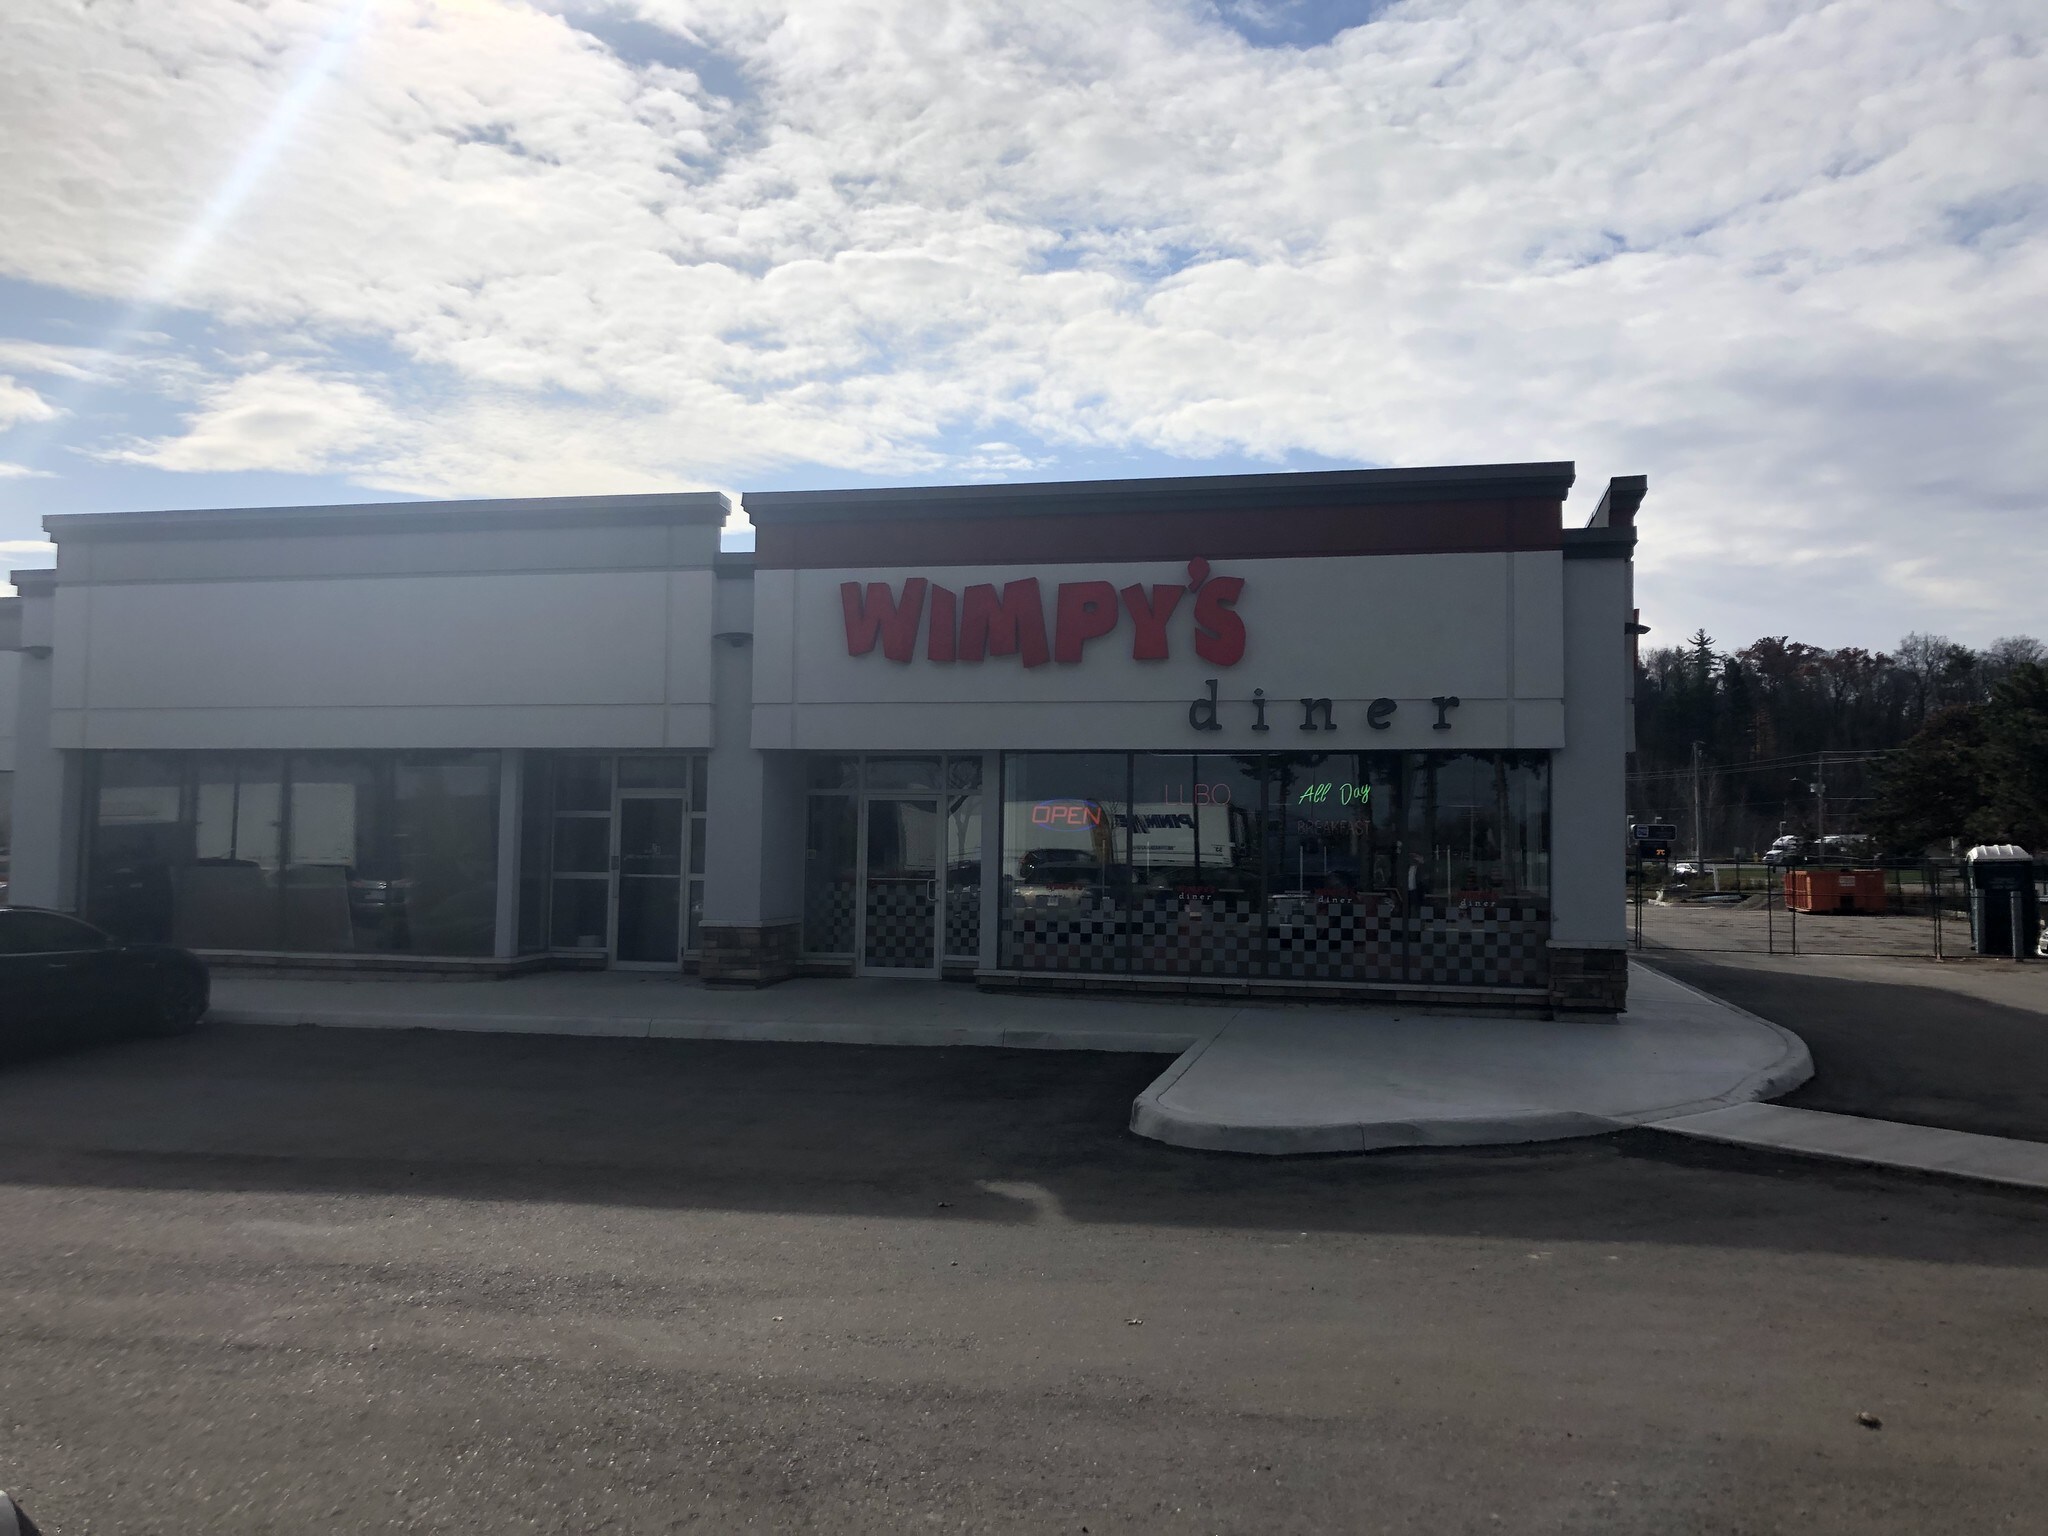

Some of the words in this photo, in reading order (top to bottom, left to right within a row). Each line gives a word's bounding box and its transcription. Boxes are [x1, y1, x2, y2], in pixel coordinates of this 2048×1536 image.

[840, 556, 1246, 668] WIMPY'S
[1188, 679, 1460, 731] diner
[1165, 783, 1231, 806] LLBO
[1298, 782, 1332, 805] All
[1339, 783, 1371, 805] Day
[1031, 805, 1101, 825] OPEN
[1297, 819, 1371, 836] BREAKFAST
[1178, 892, 1212, 900] diner
[1318, 896, 1353, 904] diner
[1460, 898, 1496, 907] diner
